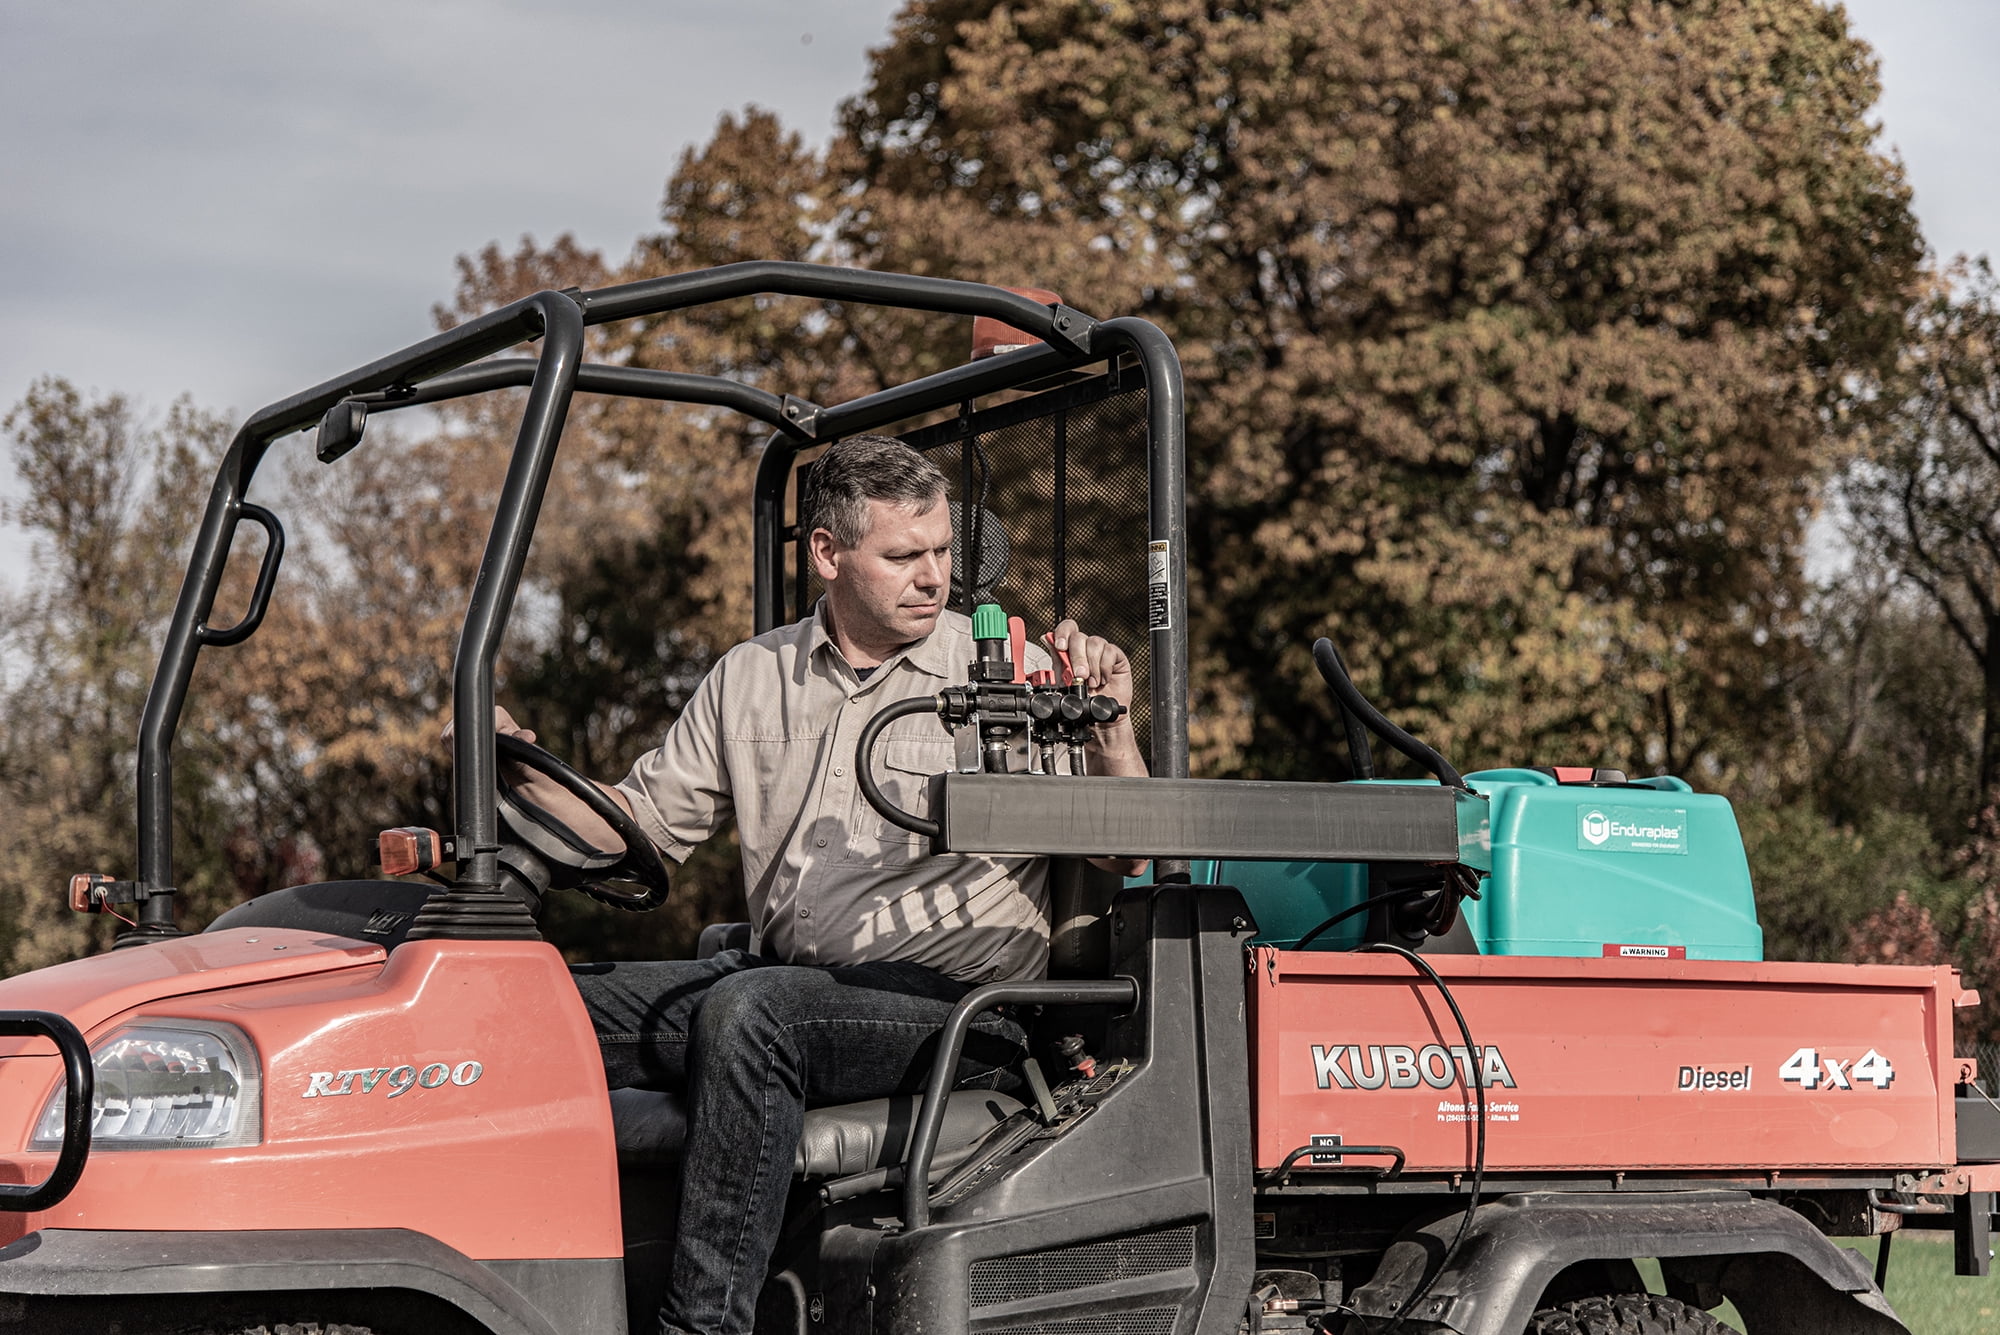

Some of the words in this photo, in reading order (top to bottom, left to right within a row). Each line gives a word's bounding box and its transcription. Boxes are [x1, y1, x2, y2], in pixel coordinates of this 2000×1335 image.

[1611, 821, 1679, 840] Enduraplas
[1629, 948, 1666, 956] WARNING
[301, 1061, 484, 1099] RTV900
[1311, 1044, 1517, 1090] KUBOTA
[1678, 1065, 1752, 1092] Diesel
[1779, 1048, 1895, 1090] 4x4
[1438, 1101, 1465, 1112] Altona
[1489, 1101, 1519, 1112] Service
